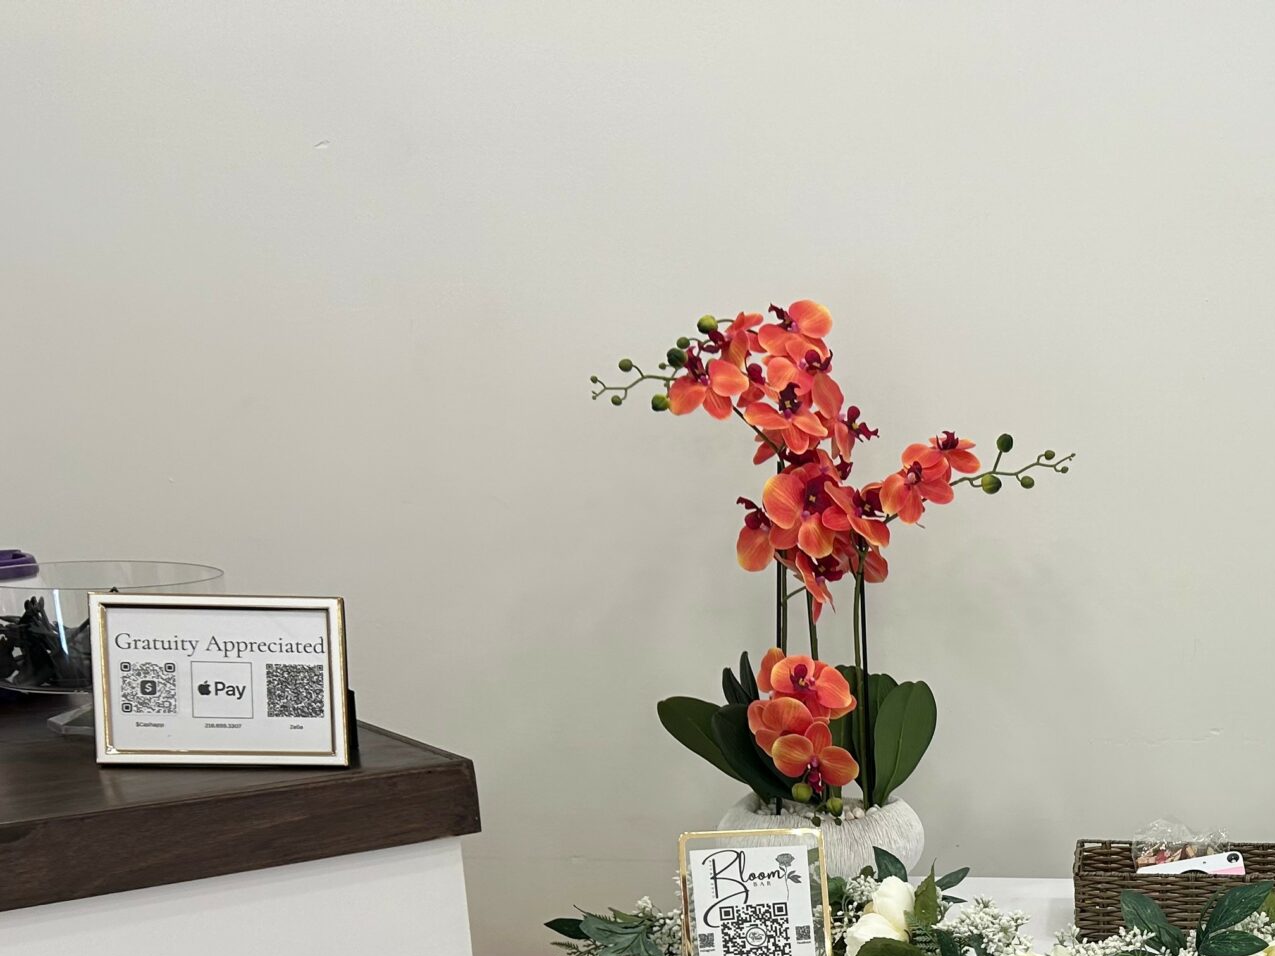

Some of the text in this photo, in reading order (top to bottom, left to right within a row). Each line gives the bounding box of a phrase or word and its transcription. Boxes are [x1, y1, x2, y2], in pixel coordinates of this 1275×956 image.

[114, 632, 326, 658] Gratuity Appreciated
[214, 681, 247, 700] Pay
[701, 849, 784, 928] Bloom
